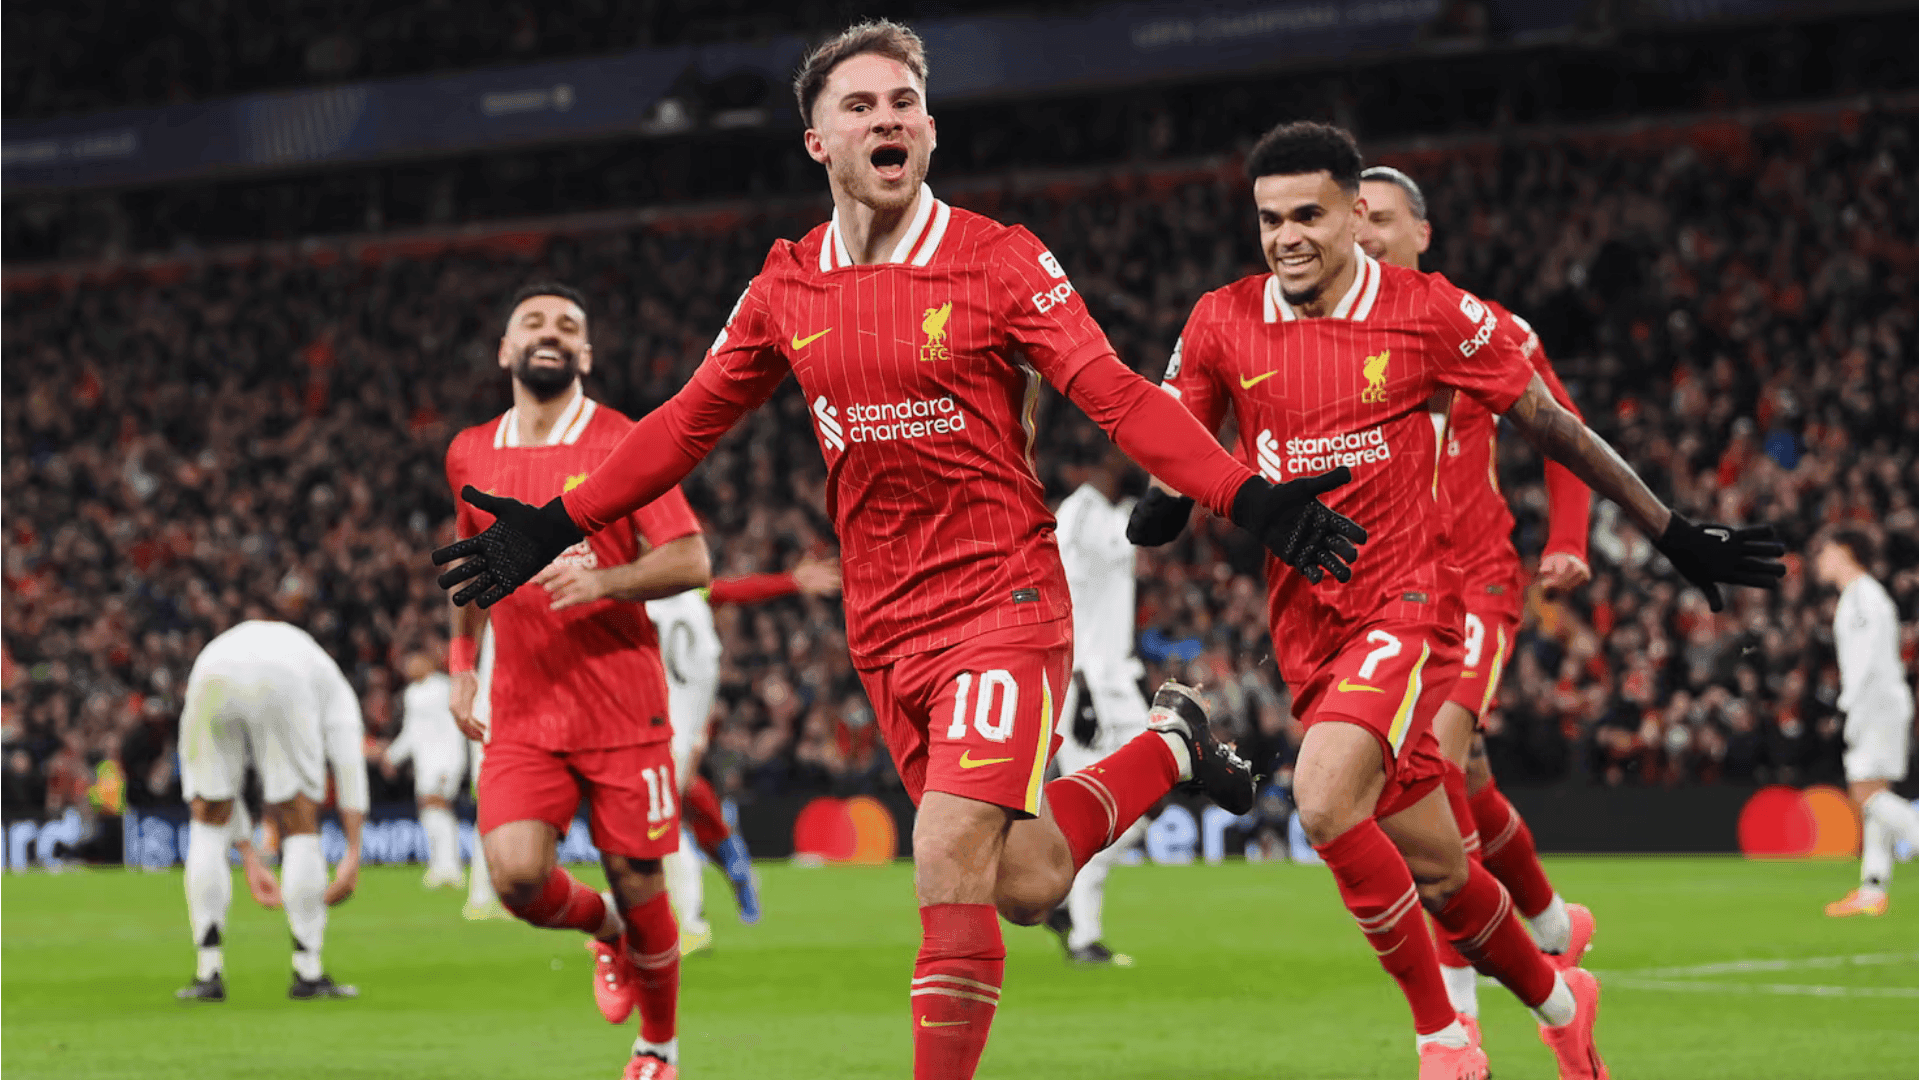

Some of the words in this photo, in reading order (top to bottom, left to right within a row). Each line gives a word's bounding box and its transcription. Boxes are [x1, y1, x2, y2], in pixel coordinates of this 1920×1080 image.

[920, 346, 948, 361] LFC
[846, 395, 955, 423] standard
[850, 411, 966, 442] chartered
[1286, 425, 1383, 455] standard
[1287, 442, 1390, 473] chartered
[1358, 629, 1401, 680] 7
[947, 669, 1019, 742] 10
[641, 765, 675, 822] 11
